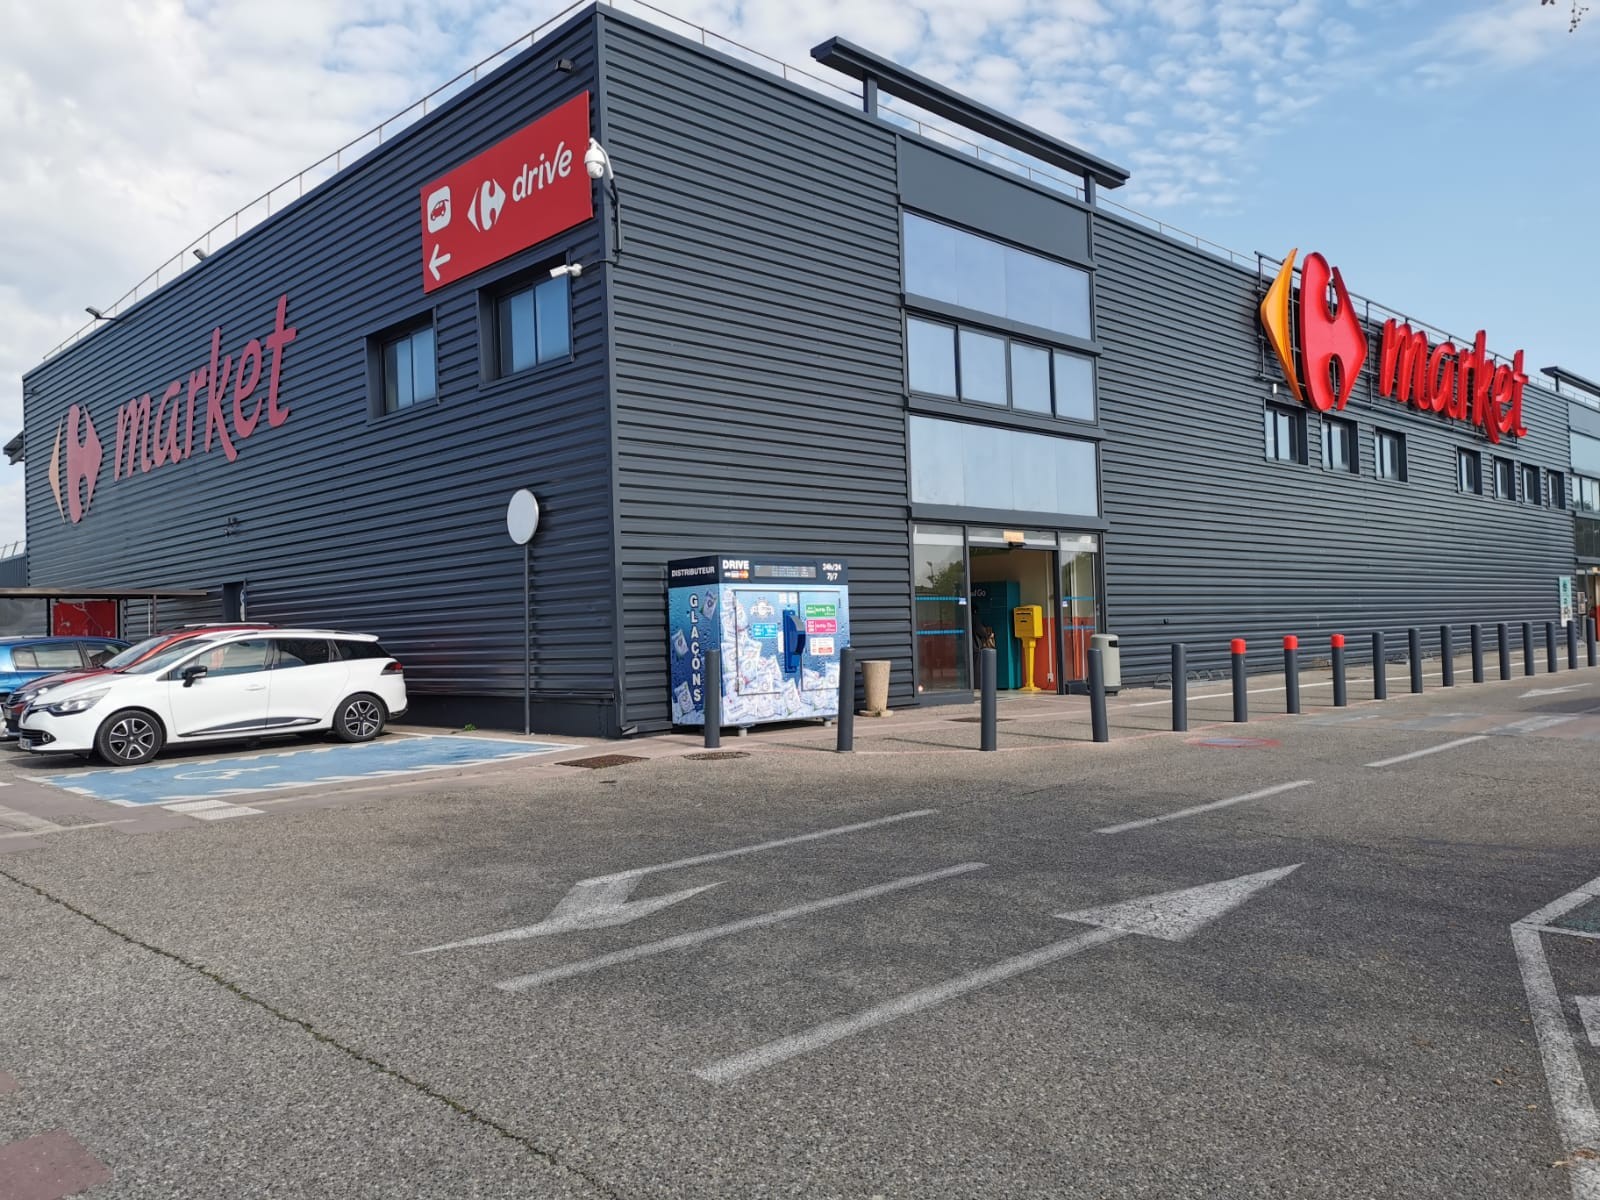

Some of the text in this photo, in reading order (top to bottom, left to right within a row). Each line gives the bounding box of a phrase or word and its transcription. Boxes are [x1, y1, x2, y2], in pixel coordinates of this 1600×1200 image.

[512, 141, 573, 202] drive
[114, 294, 297, 482] market
[1379, 318, 1529, 444] market
[671, 566, 716, 577] DISTRIBUTEUR
[722, 559, 750, 570] DRIVE
[689, 595, 701, 702] GLAÇONS
